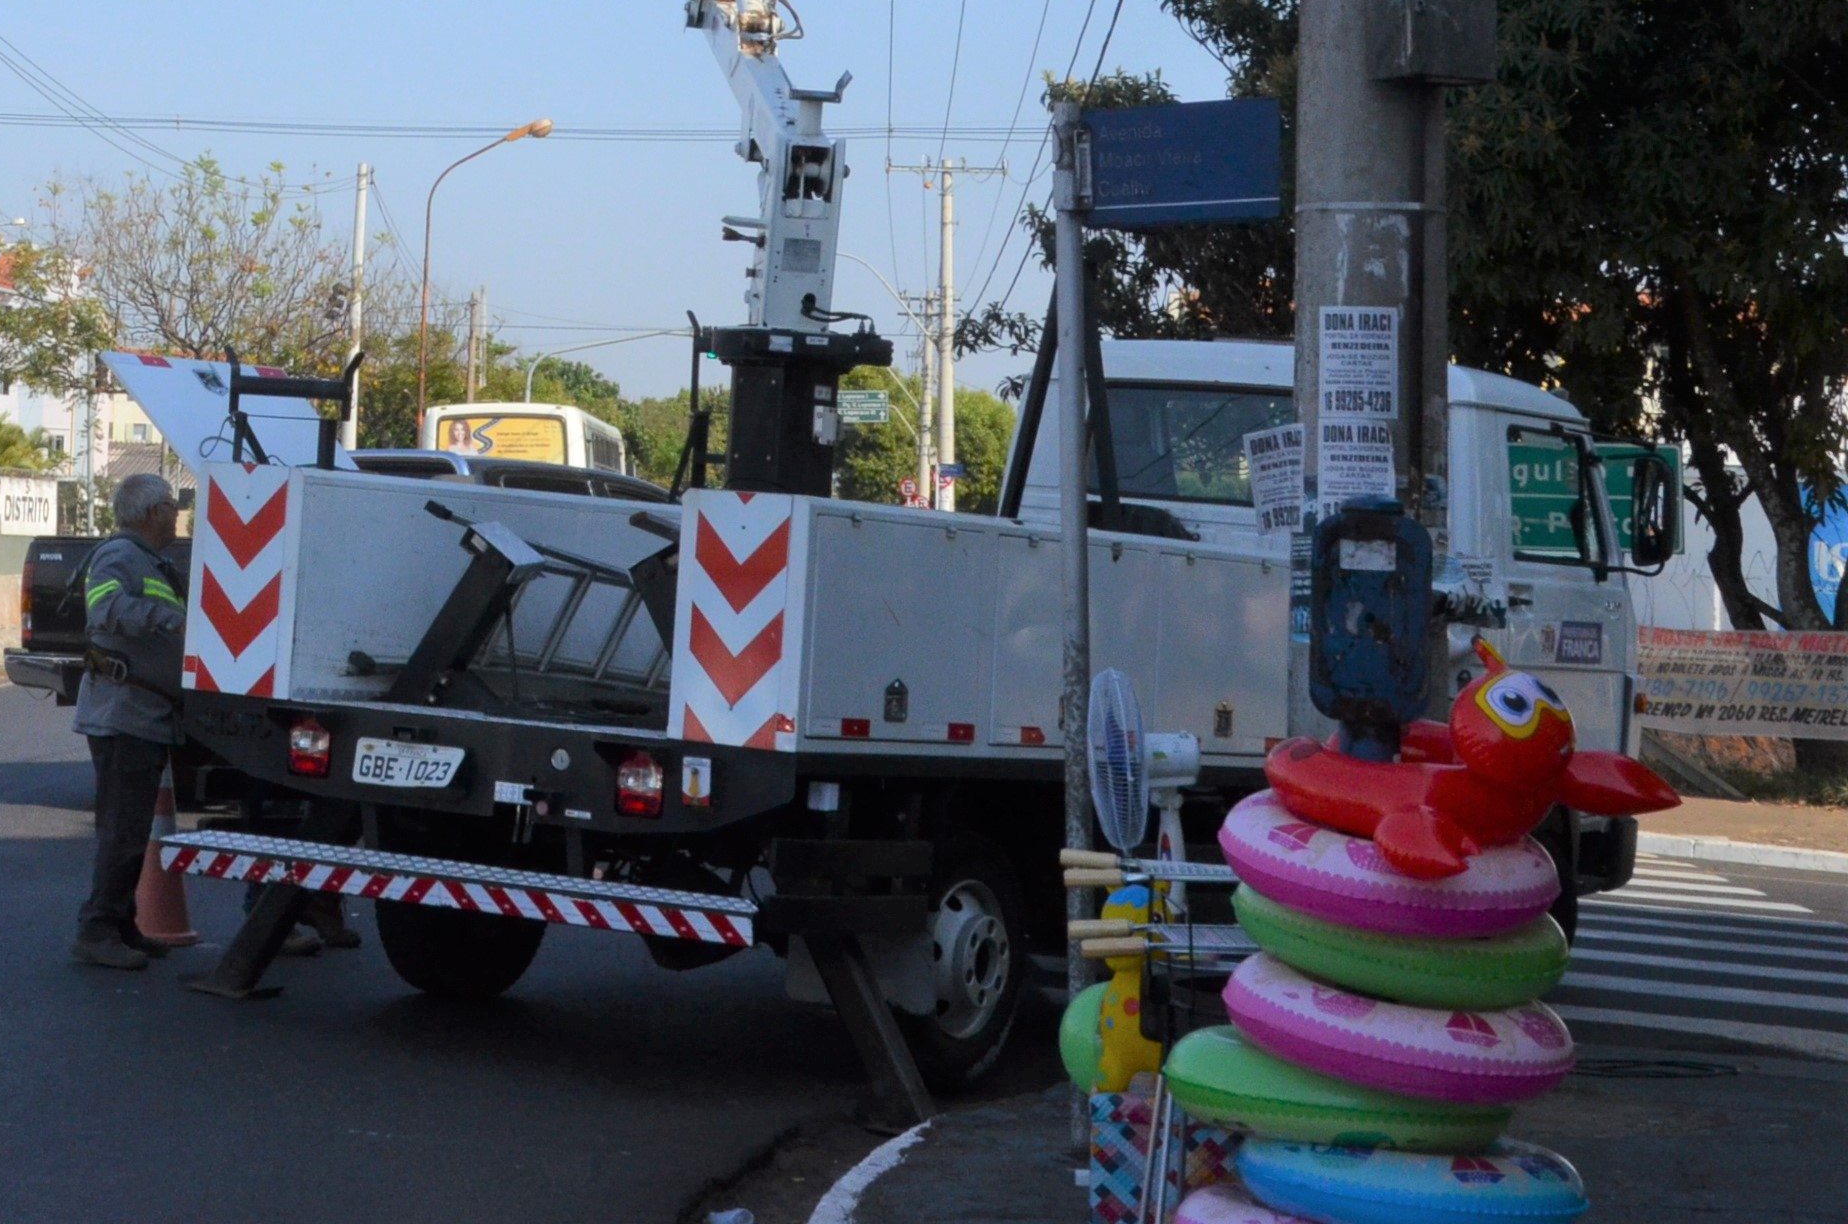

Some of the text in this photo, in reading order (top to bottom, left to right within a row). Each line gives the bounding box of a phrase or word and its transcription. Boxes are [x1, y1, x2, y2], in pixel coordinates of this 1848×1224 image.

[1325, 314, 1391, 331] DONA IRACI
[1331, 342, 1390, 350] BENZEDEIRA
[1324, 392, 1332, 411] 16
[1323, 425, 1353, 443] DONA
[1250, 434, 1280, 455] DONA
[1330, 455, 1388, 463] BENZEDEIRA
[4, 495, 49, 523] DISTRITO
[1563, 639, 1599, 657] FRANCA
[1718, 704, 1754, 721] 2060
